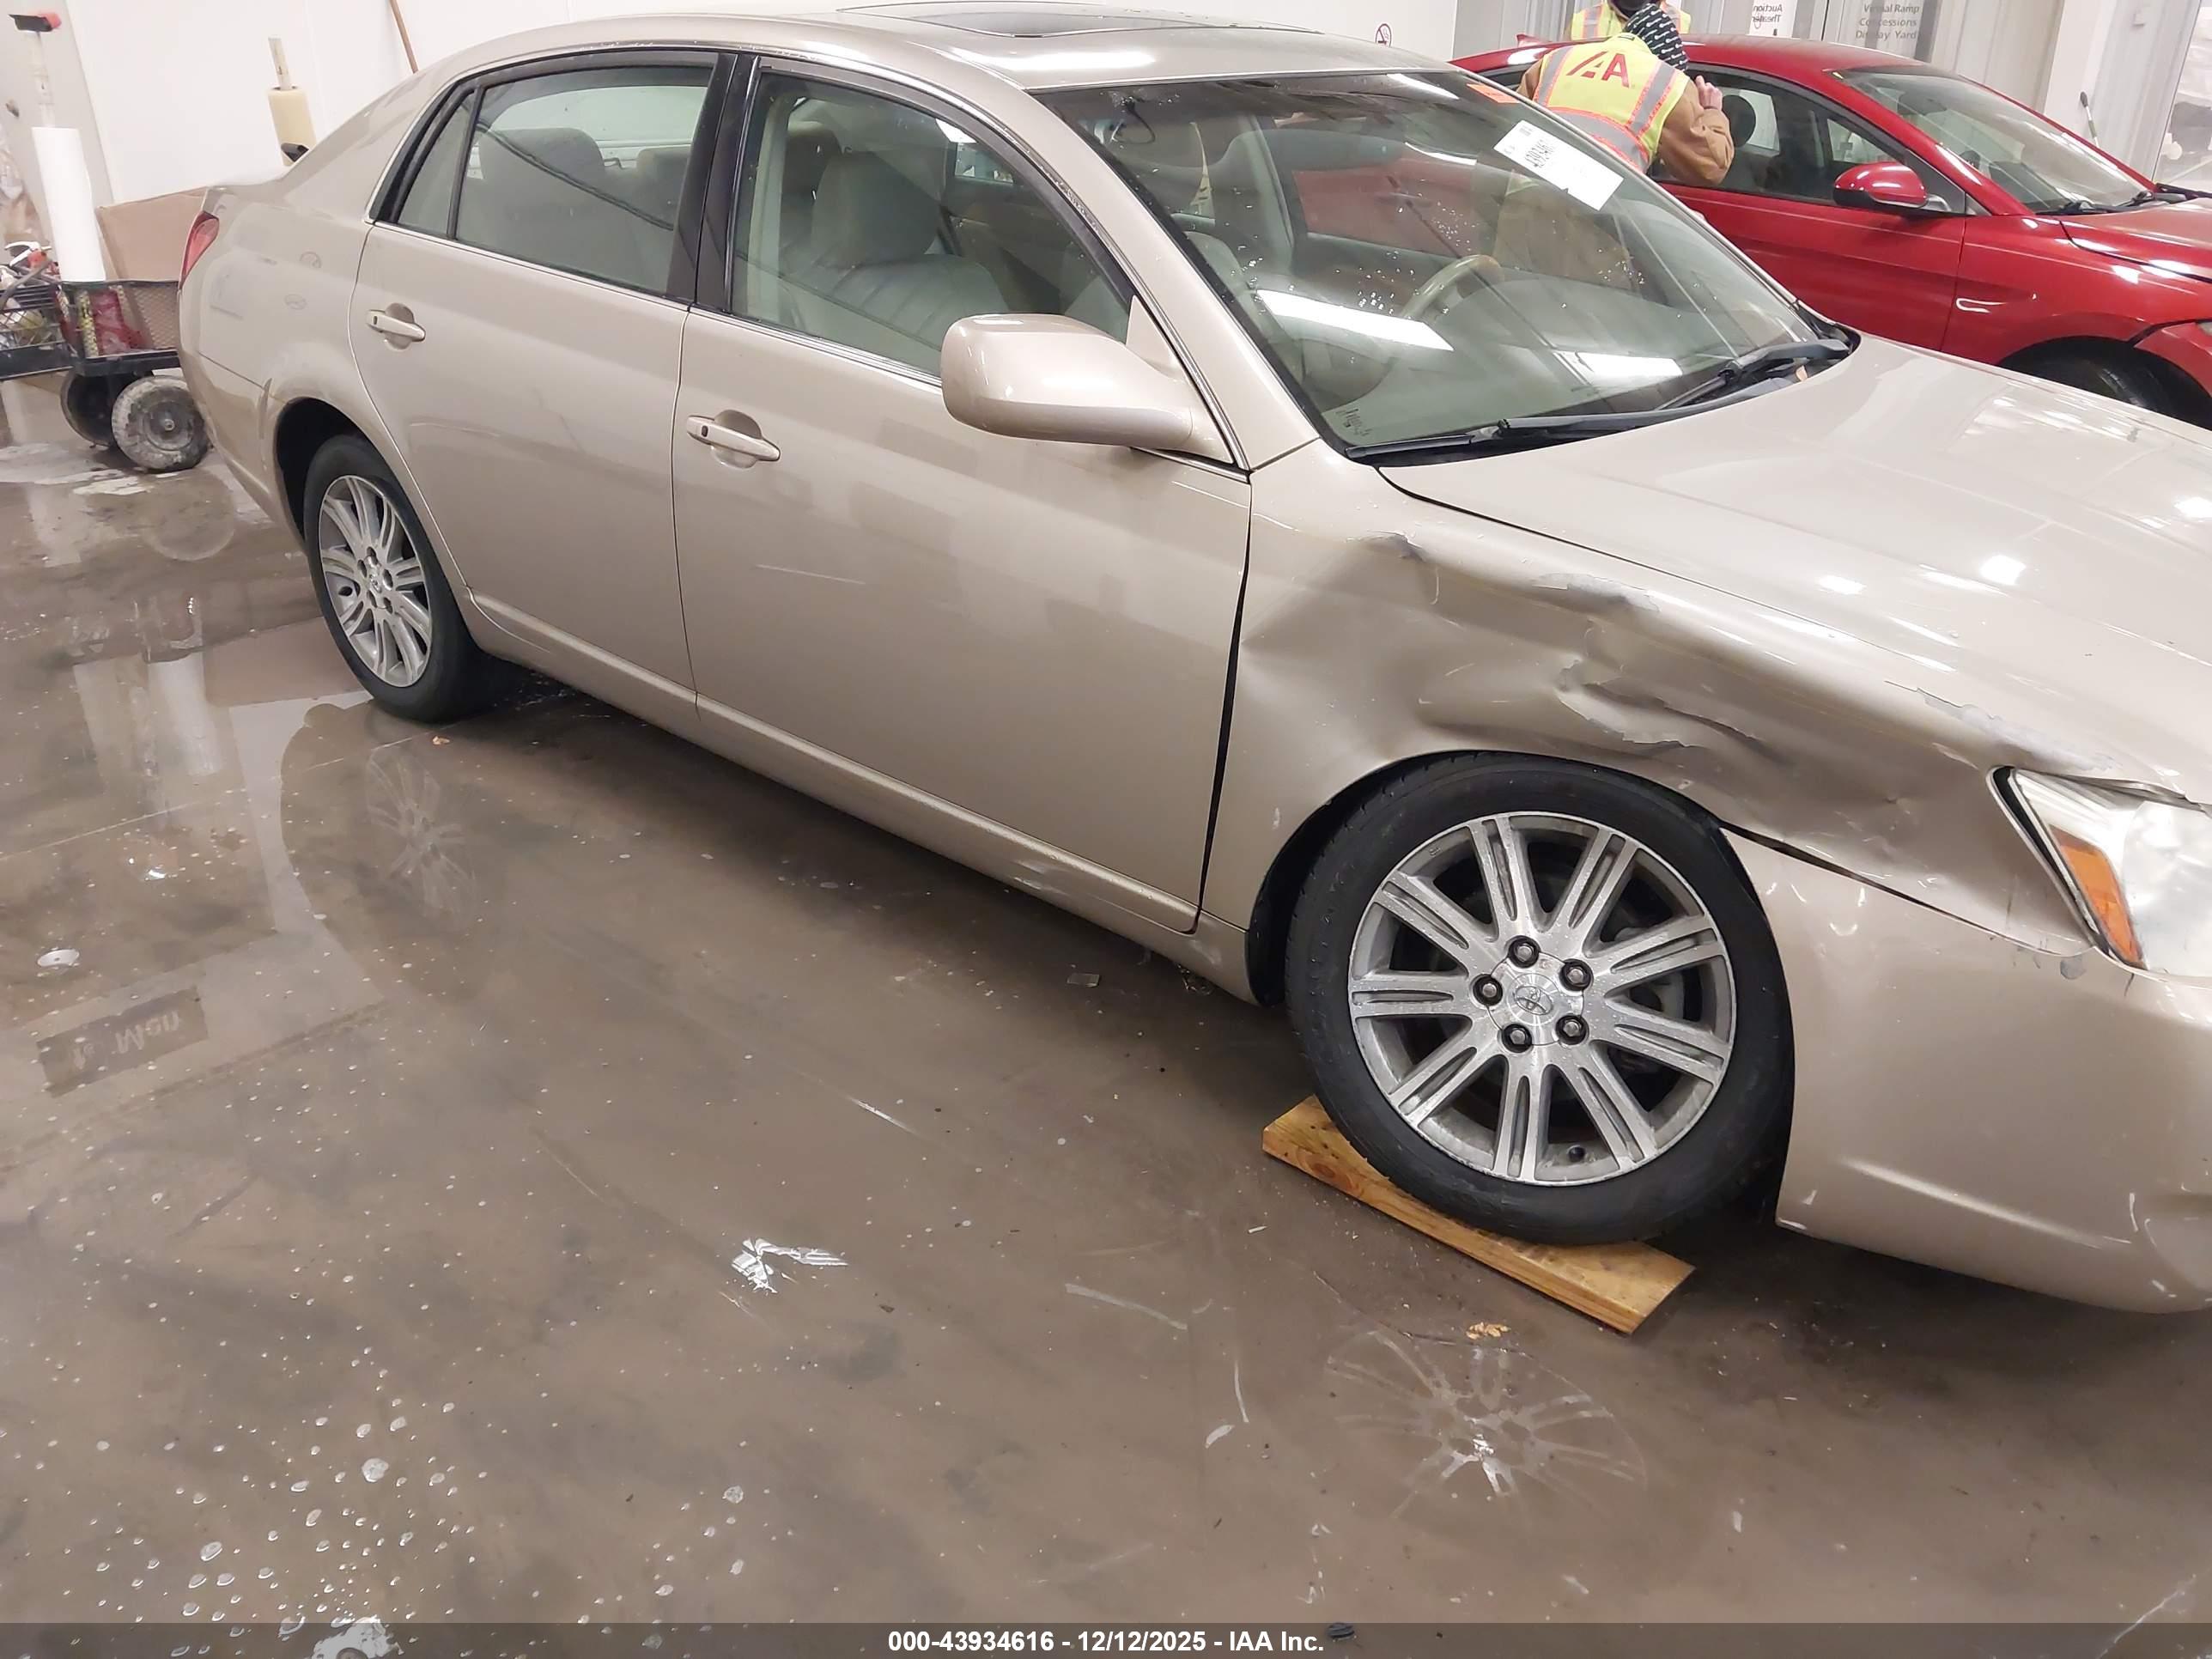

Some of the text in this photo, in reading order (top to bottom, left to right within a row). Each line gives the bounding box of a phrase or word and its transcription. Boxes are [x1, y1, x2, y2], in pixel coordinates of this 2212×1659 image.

[1864, 3, 1919, 14] Viual Ramp
[1859, 17, 1917, 27] Cocessions
[1856, 30, 1917, 40] Dilay Yard
